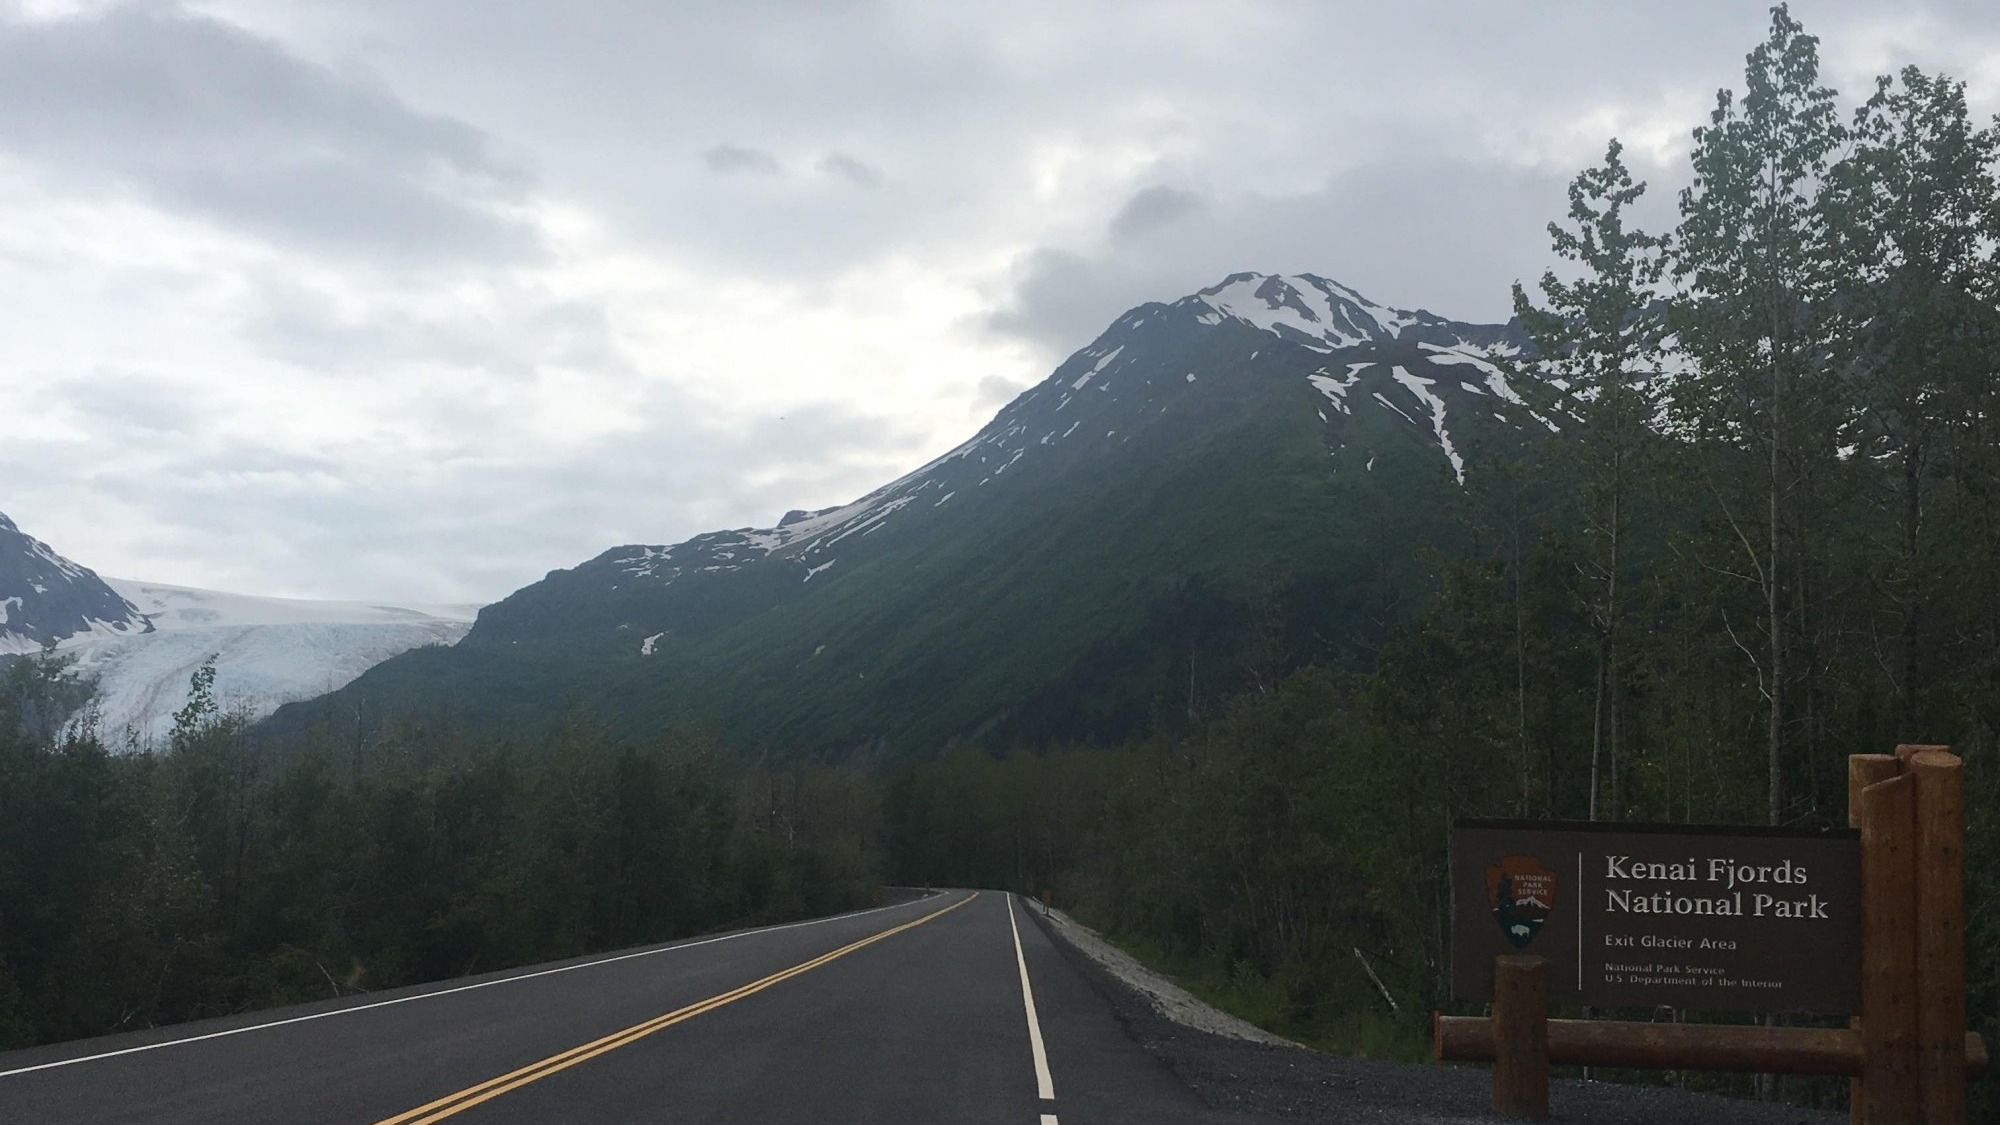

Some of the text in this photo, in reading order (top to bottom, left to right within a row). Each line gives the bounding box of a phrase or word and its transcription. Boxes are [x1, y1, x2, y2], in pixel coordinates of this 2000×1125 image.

[1514, 874, 1551, 882] NATIONAL
[1605, 855, 1808, 890] Kenai Fjords
[1605, 889, 1829, 919] National Park
[1605, 934, 1737, 950] Exit Glacier Area
[1605, 962, 1725, 975] National Park Service
[1630, 974, 1696, 985] Department
[1701, 976, 1713, 986] of
[1718, 978, 1737, 987] the
[1741, 978, 1783, 988] Interior
